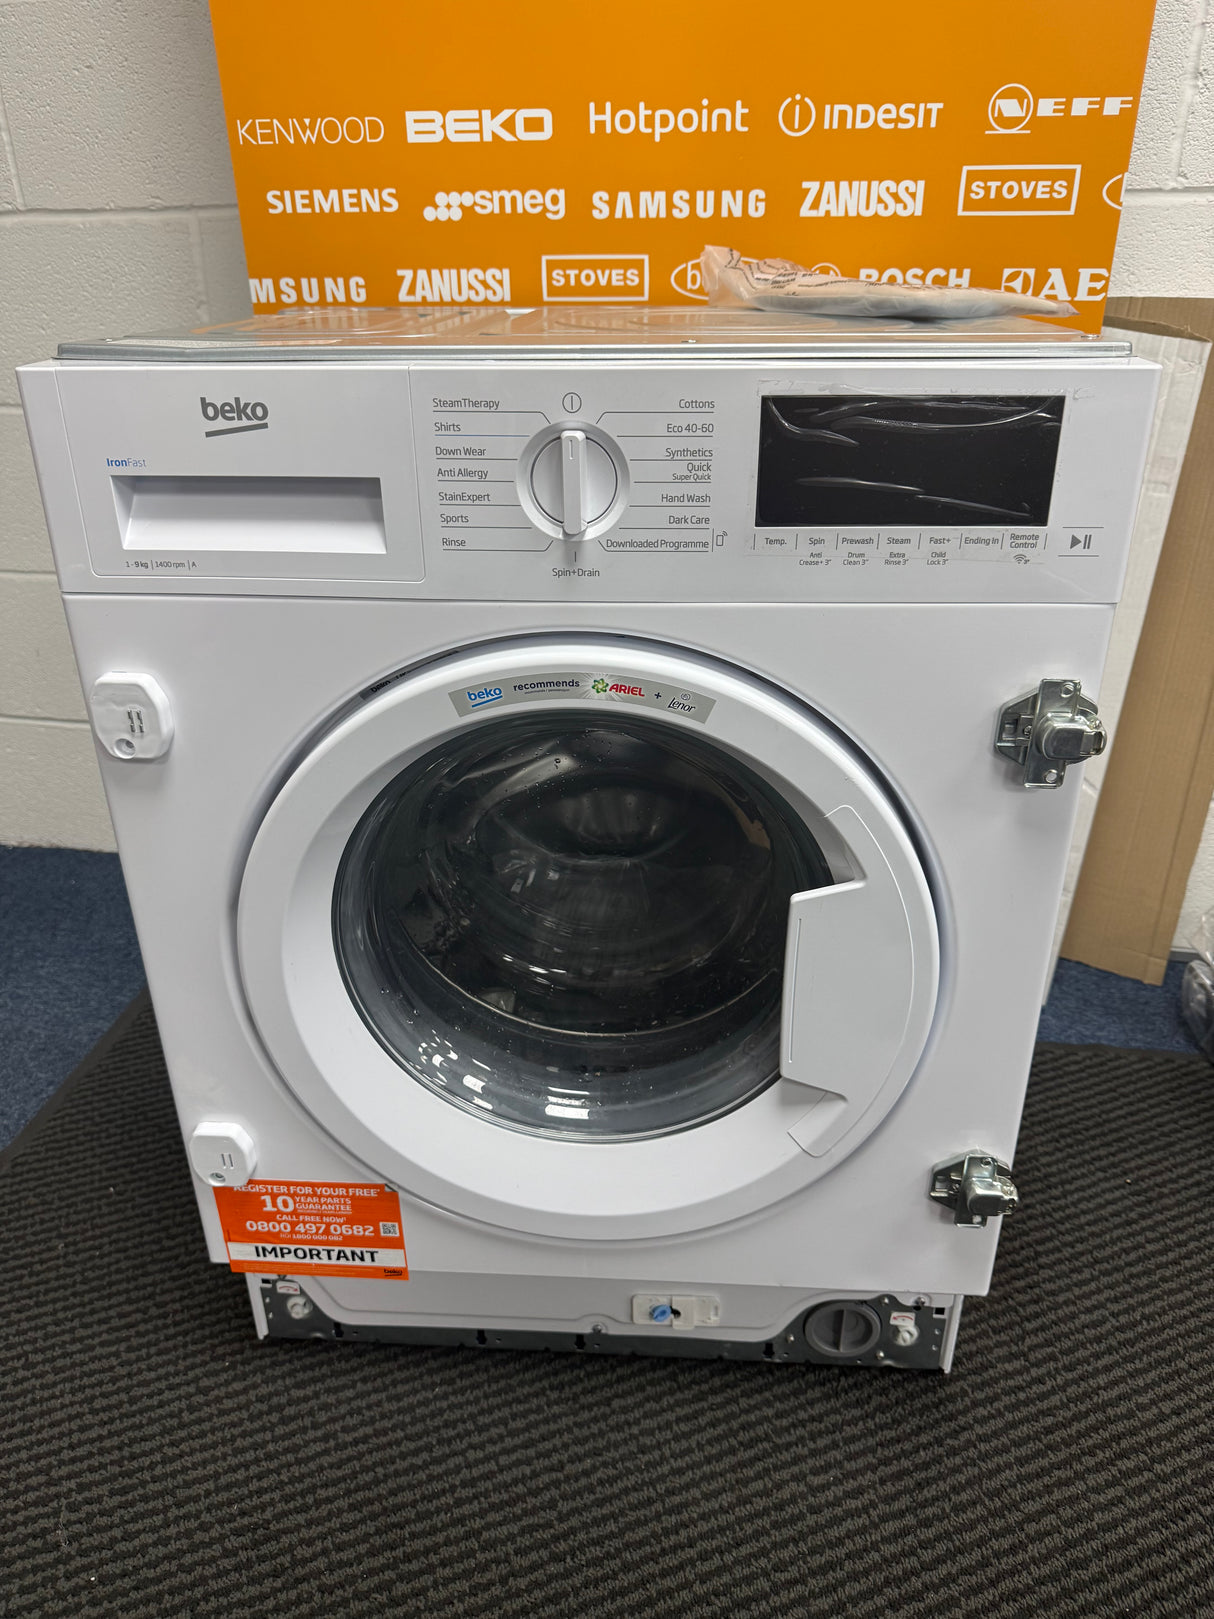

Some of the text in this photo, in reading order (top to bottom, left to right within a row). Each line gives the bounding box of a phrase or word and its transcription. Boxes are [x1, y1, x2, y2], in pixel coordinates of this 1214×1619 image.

[405, 108, 553, 143] BEKO
[588, 98, 750, 143] Hotpoint
[236, 116, 385, 145] KENWOOD
[969, 180, 1069, 200] STOVES
[266, 187, 399, 215] SIEMENS
[474, 187, 566, 221] smeg
[591, 188, 767, 220] SAMSUNG
[799, 179, 926, 218] ZANUSSI
[551, 268, 640, 287] STOVES
[396, 268, 511, 302] ZANUSSI
[200, 396, 269, 422] beko
[678, 398, 715, 409] Cottons
[434, 421, 461, 432] Shirts
[666, 422, 714, 433] Eco 40-60
[435, 446, 487, 457] Down Wear
[665, 447, 713, 459] Synthetics
[106, 457, 147, 468] IronFast
[686, 462, 712, 473] Quick
[437, 467, 489, 480] Anti Allergy
[672, 473, 712, 482] Super Quick
[438, 491, 491, 503] StainExpert
[661, 492, 711, 503] Hand Wash
[440, 513, 469, 526] Sports
[668, 514, 710, 525] Dark Care
[441, 536, 466, 547] Rinse
[764, 537, 787, 546] Temp.
[808, 536, 825, 546] Spin
[841, 536, 874, 545] Prewash
[886, 536, 911, 545] Steam
[929, 536, 951, 545] Fast+
[964, 536, 999, 546] Ending In
[1009, 533, 1040, 541] Remote
[606, 538, 709, 551] Downloaded Programme
[1009, 541, 1038, 549] Control
[155, 560, 171, 568] 1400
[843, 558, 861, 566] Clean
[884, 558, 901, 566] Rinse
[926, 558, 941, 566] Lock
[552, 567, 600, 578] Spin+Drain
[513, 679, 580, 692] recommends
[609, 683, 645, 697] ARIEL
[467, 687, 503, 702] beko
[667, 696, 697, 714] Lenor
[290, 1185, 313, 1195] FOR
[315, 1187, 348, 1196] YOUR
[260, 1195, 294, 1213] 10
[294, 1196, 319, 1204] YEAR
[296, 1203, 352, 1211] GUARANTEE
[276, 1214, 299, 1222] CALL
[245, 1220, 375, 1237] 0800 497 0682
[254, 1245, 379, 1263] IMPORTANT
